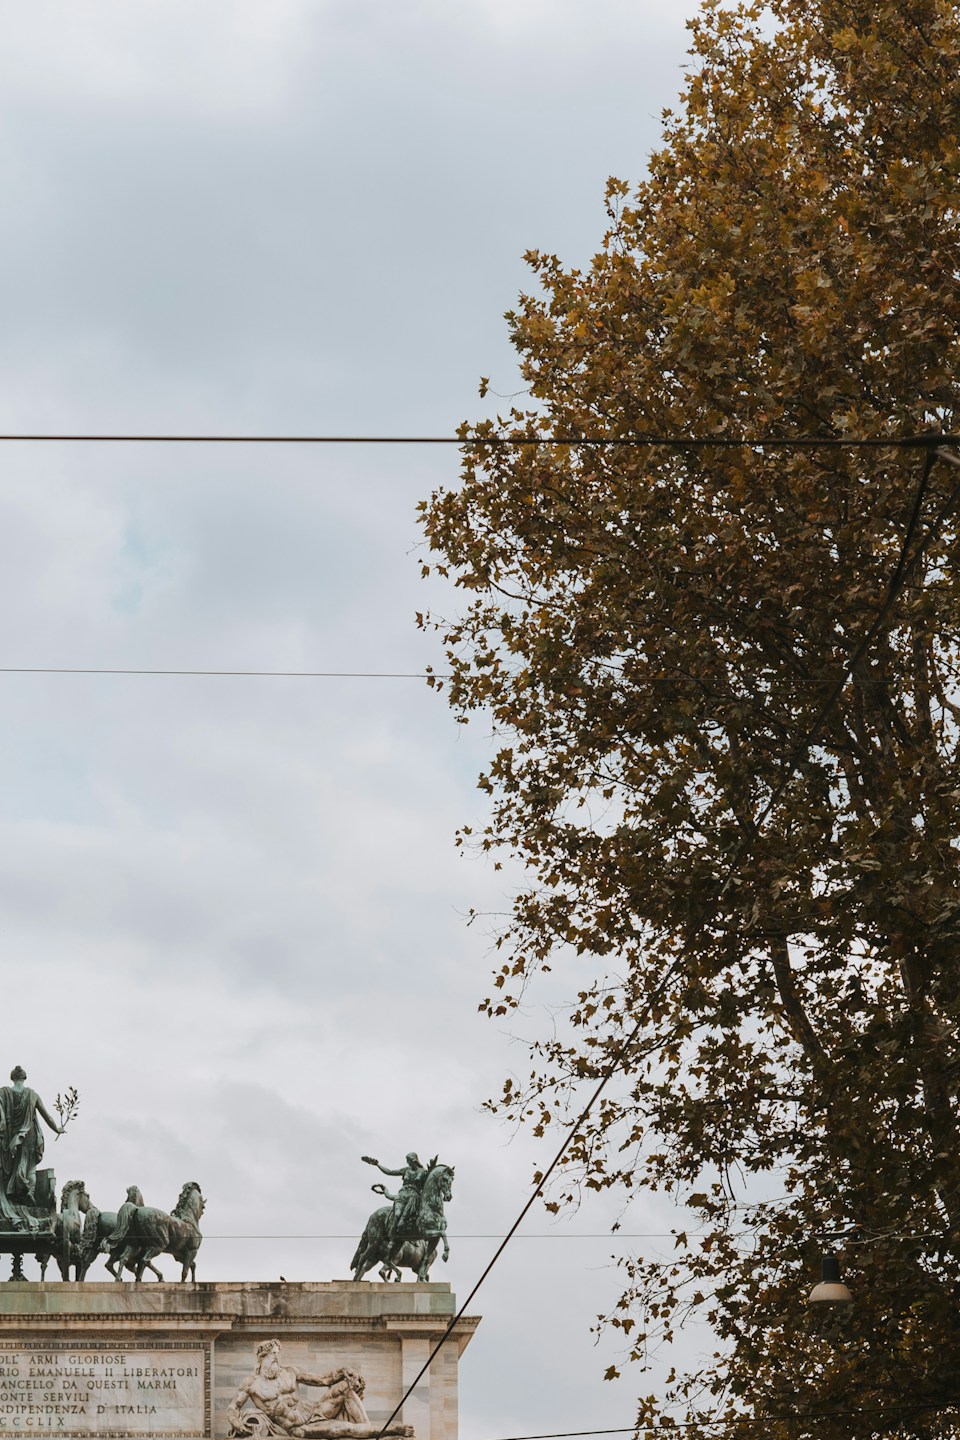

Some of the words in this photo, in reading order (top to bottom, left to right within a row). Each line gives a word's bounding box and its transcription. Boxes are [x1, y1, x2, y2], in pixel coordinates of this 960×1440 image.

[29, 1355, 59, 1365] ARMI
[68, 1355, 127, 1365] GLORIOSE
[29, 1367, 96, 1377] EMANUELE
[105, 1367, 114, 1377] II
[123, 1367, 199, 1377] LIBERATORI
[62, 1380, 78, 1390] DA
[87, 1379, 129, 1391] QUESTI
[137, 1379, 177, 1390] MARMI
[43, 1392, 90, 1402] SERVILI
[115, 1404, 158, 1415] ITALIA
